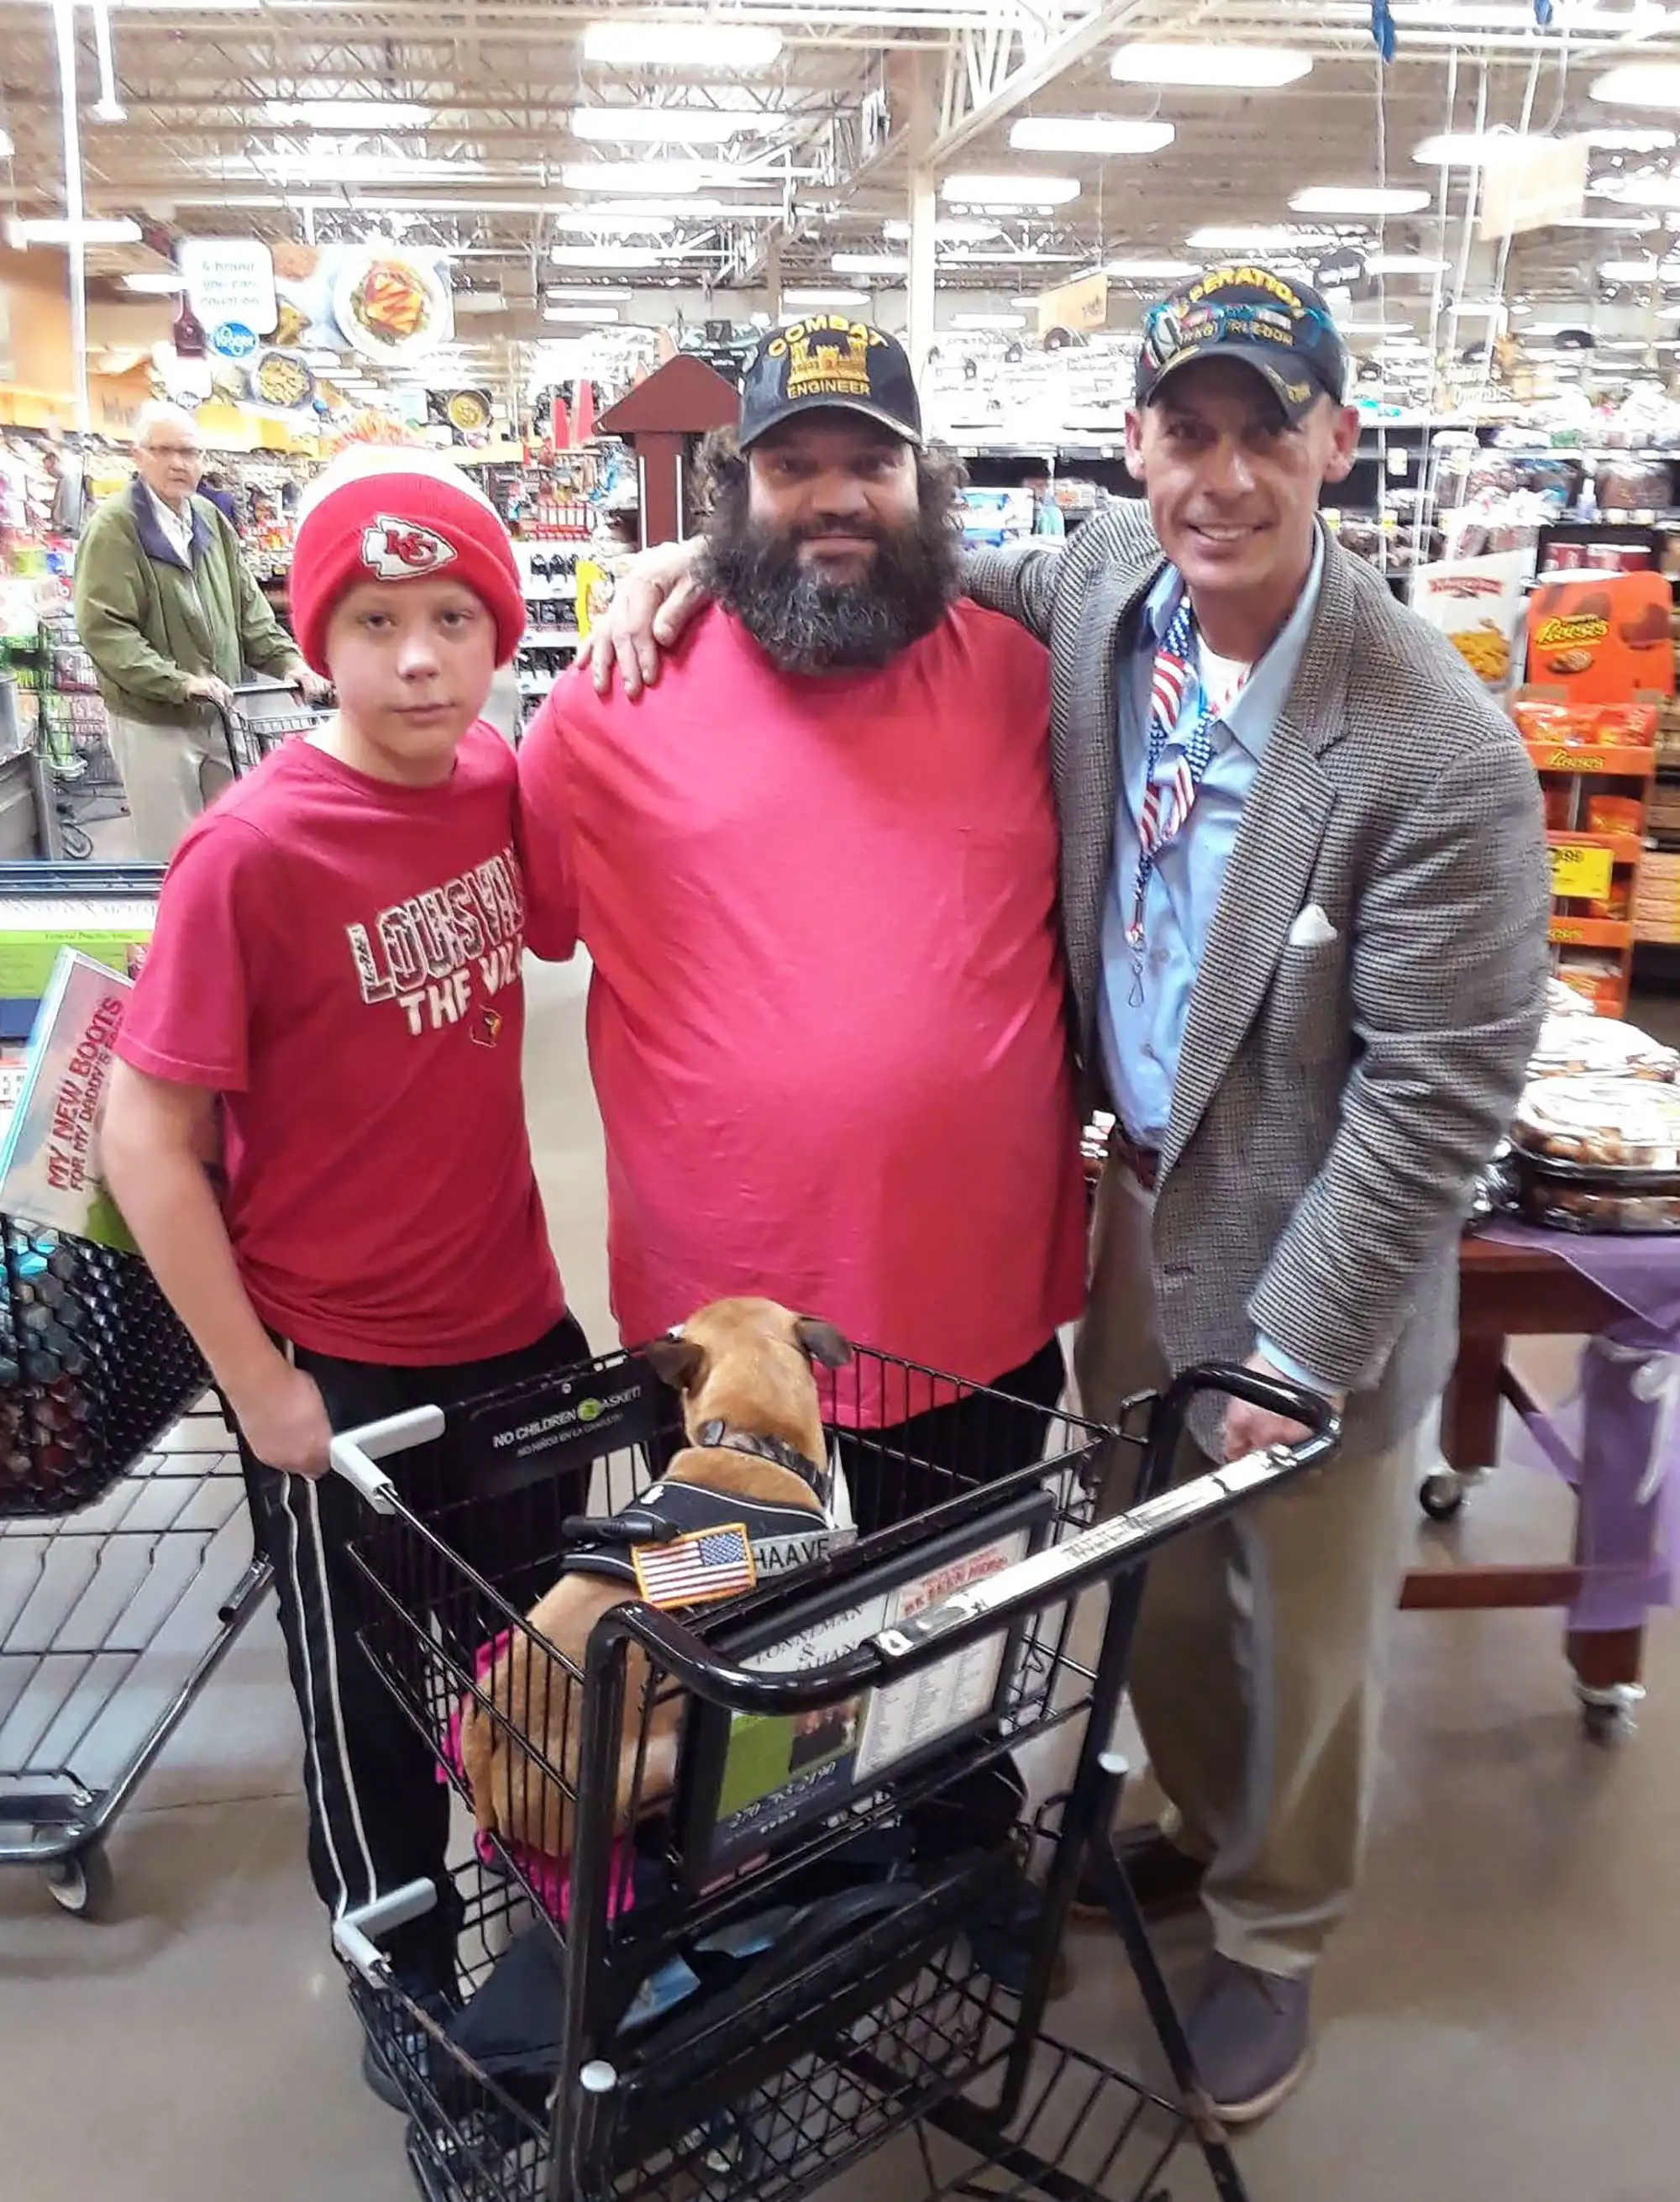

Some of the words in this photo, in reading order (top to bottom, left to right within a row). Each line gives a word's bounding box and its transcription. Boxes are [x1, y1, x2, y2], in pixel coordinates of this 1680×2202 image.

[768, 314, 890, 357] COMBAT
[785, 378, 872, 401] ENGINEER
[397, 967, 473, 1037] THE
[69, 996, 124, 1077] BOOTS
[52, 1079, 83, 1142] NEW
[47, 1142, 71, 1191] MY
[70, 1154, 87, 1192] FOR
[492, 1430, 515, 1448] NO
[516, 1408, 577, 1441] CHILDREN
